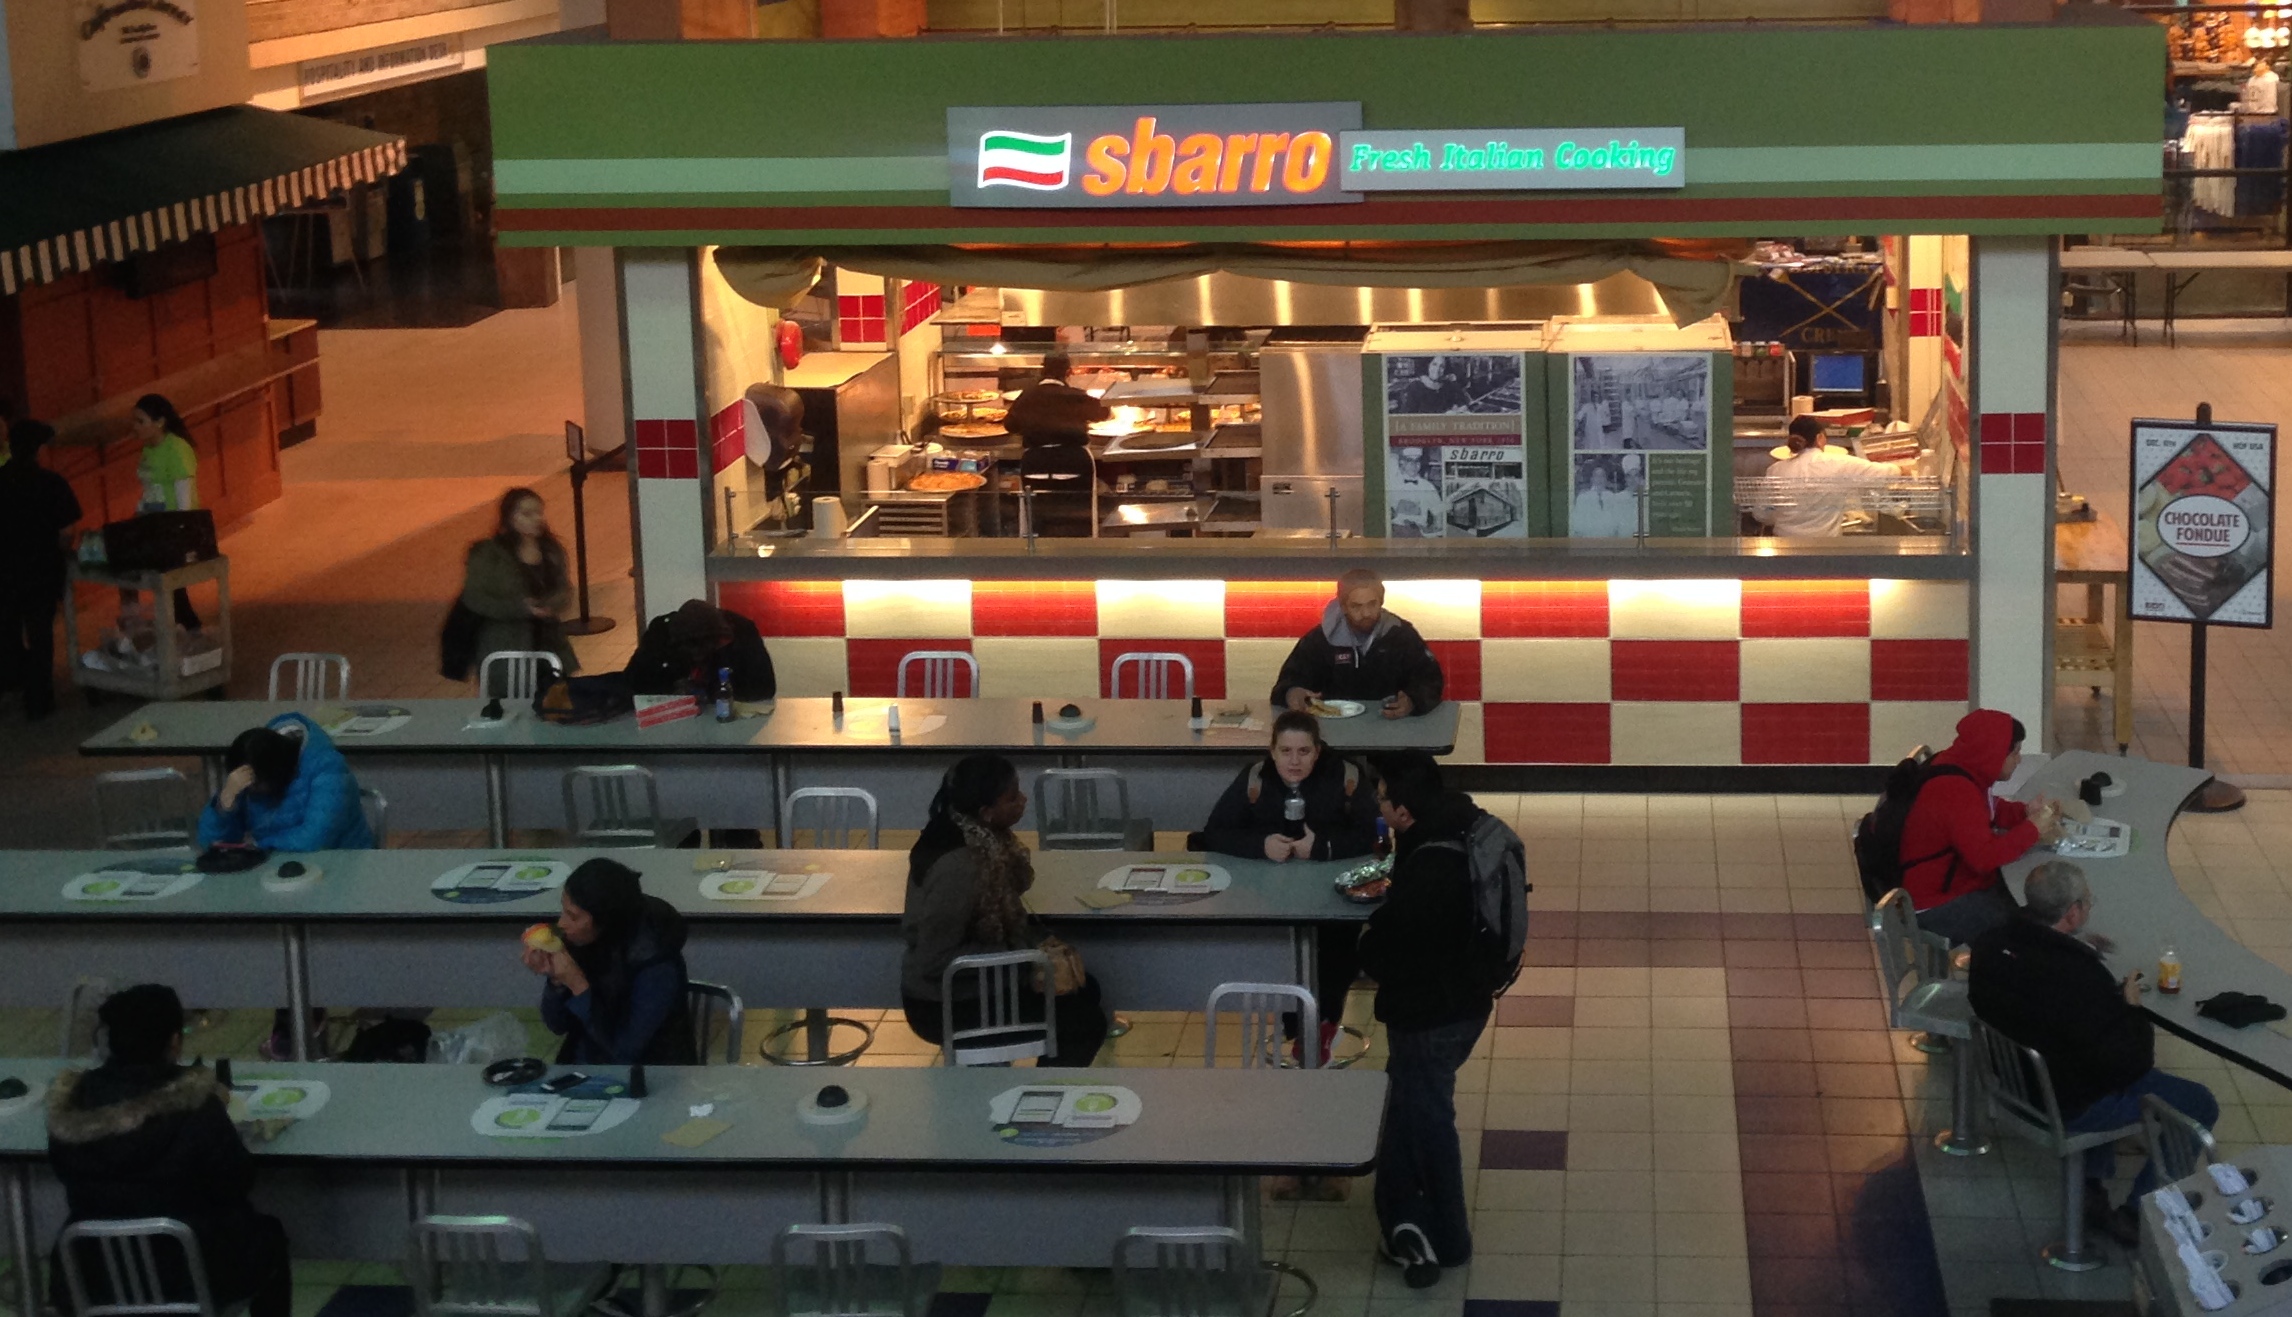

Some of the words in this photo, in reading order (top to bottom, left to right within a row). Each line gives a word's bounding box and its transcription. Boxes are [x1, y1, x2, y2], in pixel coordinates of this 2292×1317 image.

[1081, 116, 1332, 196] sbarro
[1350, 142, 1431, 172] Fresh
[1439, 141, 1544, 171] Italian
[1554, 140, 1676, 176] Cooking
[1410, 422, 1447, 431] FAMILY
[1450, 448, 1505, 460] sbarro
[2164, 511, 2240, 527] CHOCOLATE
[2176, 527, 2231, 542] FONDUE
